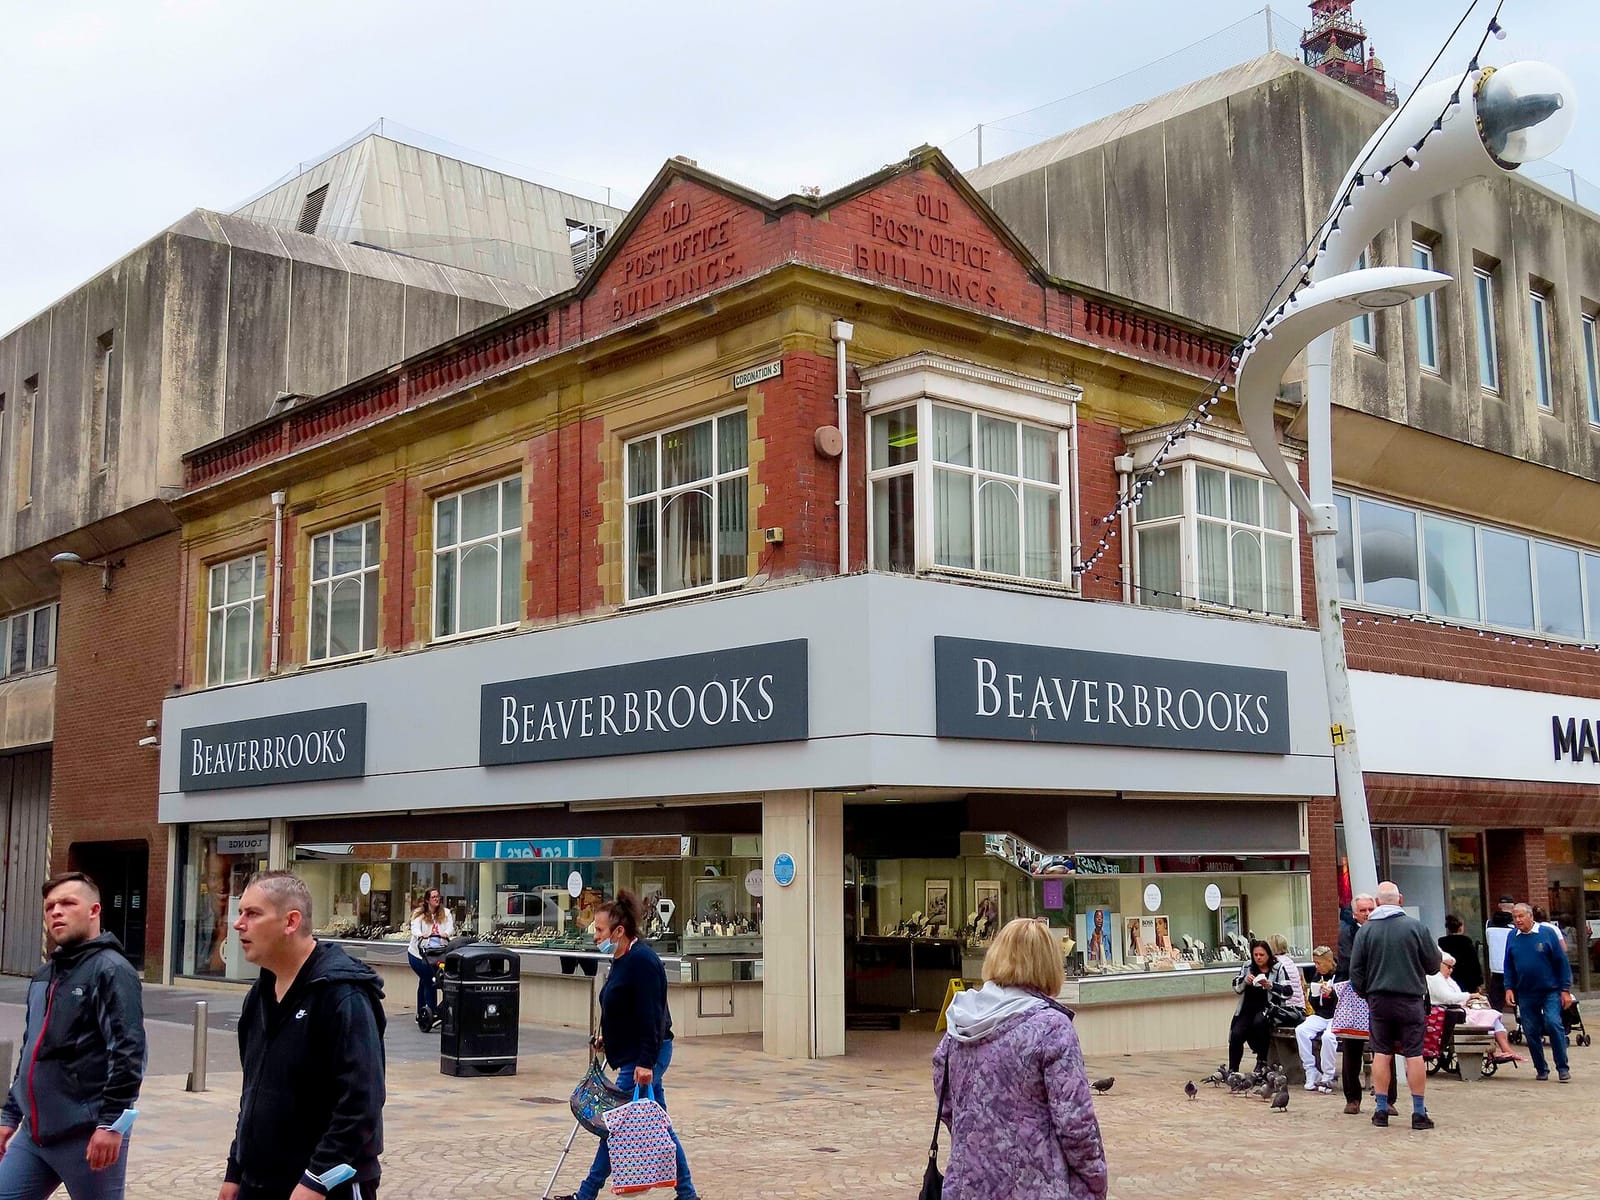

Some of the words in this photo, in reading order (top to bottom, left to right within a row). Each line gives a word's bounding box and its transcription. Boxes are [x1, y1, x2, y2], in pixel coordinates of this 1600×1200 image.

[663, 202, 692, 233] OLD
[917, 194, 949, 224] OLD
[624, 245, 668, 284] POST
[672, 219, 729, 264] OFFICE
[872, 212, 925, 251] POST
[929, 233, 992, 273] OFFICE
[735, 366, 772, 386] CORONATION
[500, 675, 774, 745] BEAVERBROOKS
[973, 657, 1269, 735] BEAVERBROOKS
[191, 728, 346, 776] BEAVERBROOKS
[1330, 725, 1344, 743] H
